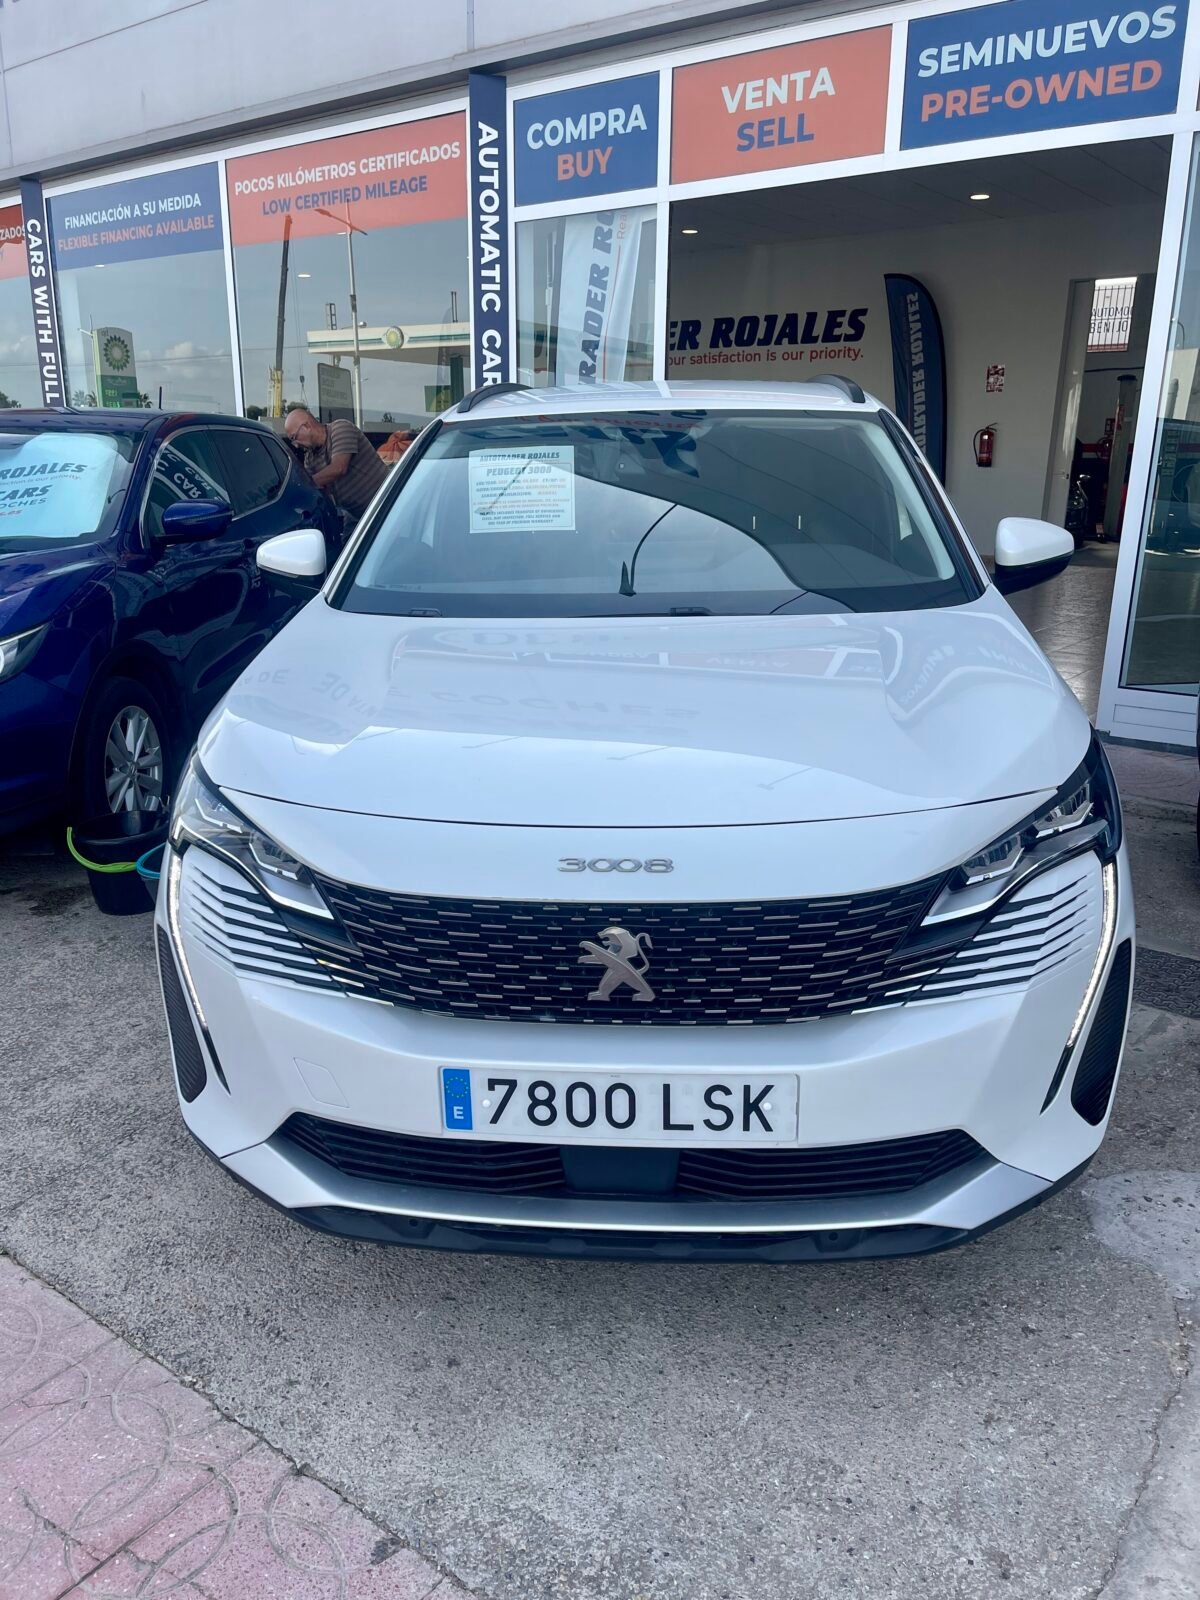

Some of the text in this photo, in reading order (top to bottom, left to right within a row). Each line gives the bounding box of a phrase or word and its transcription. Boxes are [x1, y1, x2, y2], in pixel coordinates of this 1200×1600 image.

[917, 5, 1176, 78] SEMINUEVOS
[721, 67, 836, 114] VENTA
[920, 59, 1162, 122] PRE-OWNED
[526, 104, 648, 151] COMPRA
[735, 113, 815, 153] SELL
[234, 142, 461, 196] POCOS KILÓMETROS CERTIFICADOS
[556, 147, 613, 181] BUY
[64, 193, 202, 230] FINANCIACIÓN A SU MEDIDA
[262, 175, 428, 216] LOW CERTIFIED MILEAGE
[58, 214, 215, 251] FLEXIBLE FINANCING AVAILABLE
[478, 121, 501, 313] AUTOMATIC
[26, 218, 60, 404] CARS WITH FULL
[579, 263, 610, 385] RADER
[709, 308, 869, 349] ROJALES
[689, 349, 761, 366] satisfaction
[766, 349, 777, 362] is
[782, 350, 804, 362] our
[809, 345, 864, 363] priority.
[0, 462, 88, 480] ROJALES
[527, 452, 560, 460] ROJALES
[557, 858, 674, 873] 3008
[452, 1106, 464, 1120] E
[487, 1078, 775, 1132] 7800 LSK
